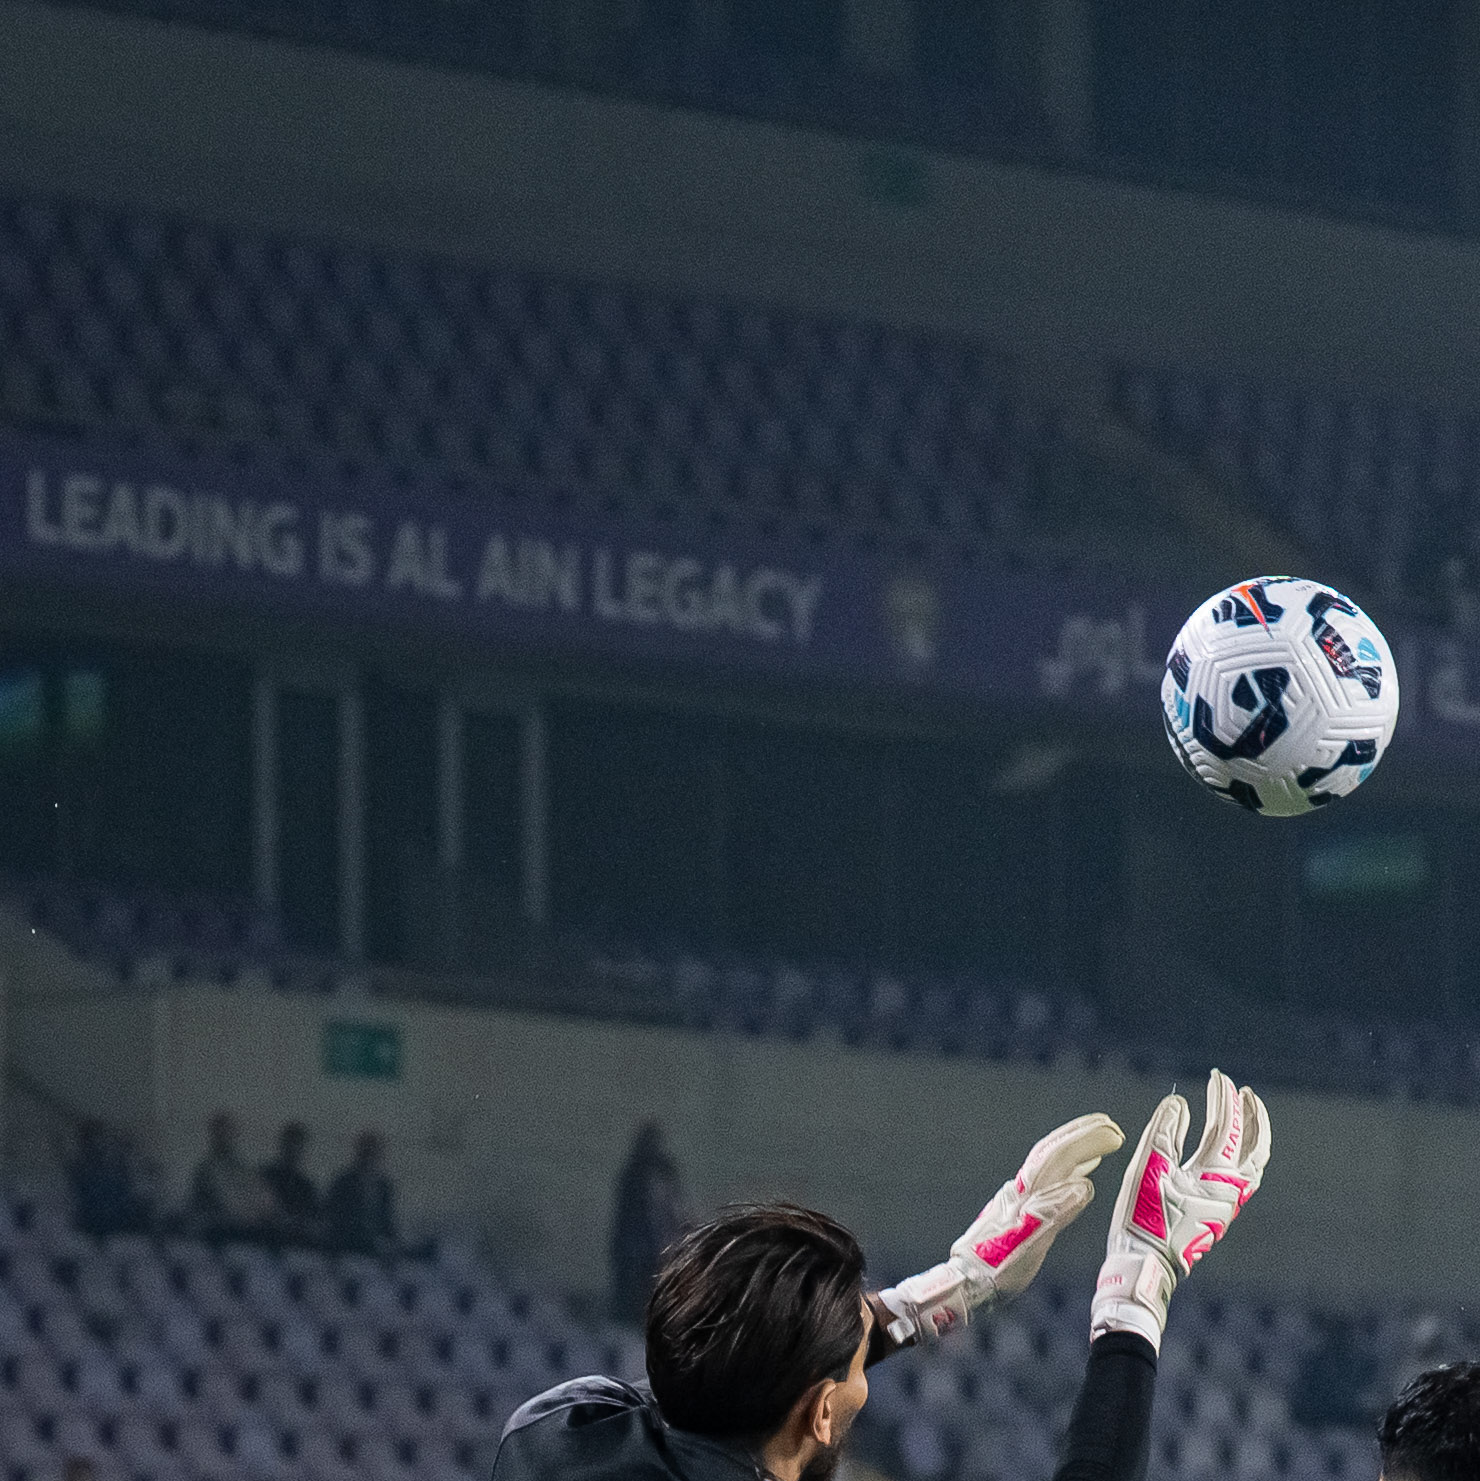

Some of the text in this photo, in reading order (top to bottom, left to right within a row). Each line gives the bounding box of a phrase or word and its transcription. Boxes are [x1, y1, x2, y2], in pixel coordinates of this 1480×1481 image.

[25, 469, 826, 645] LEADING IS AL AIN LEGACY
